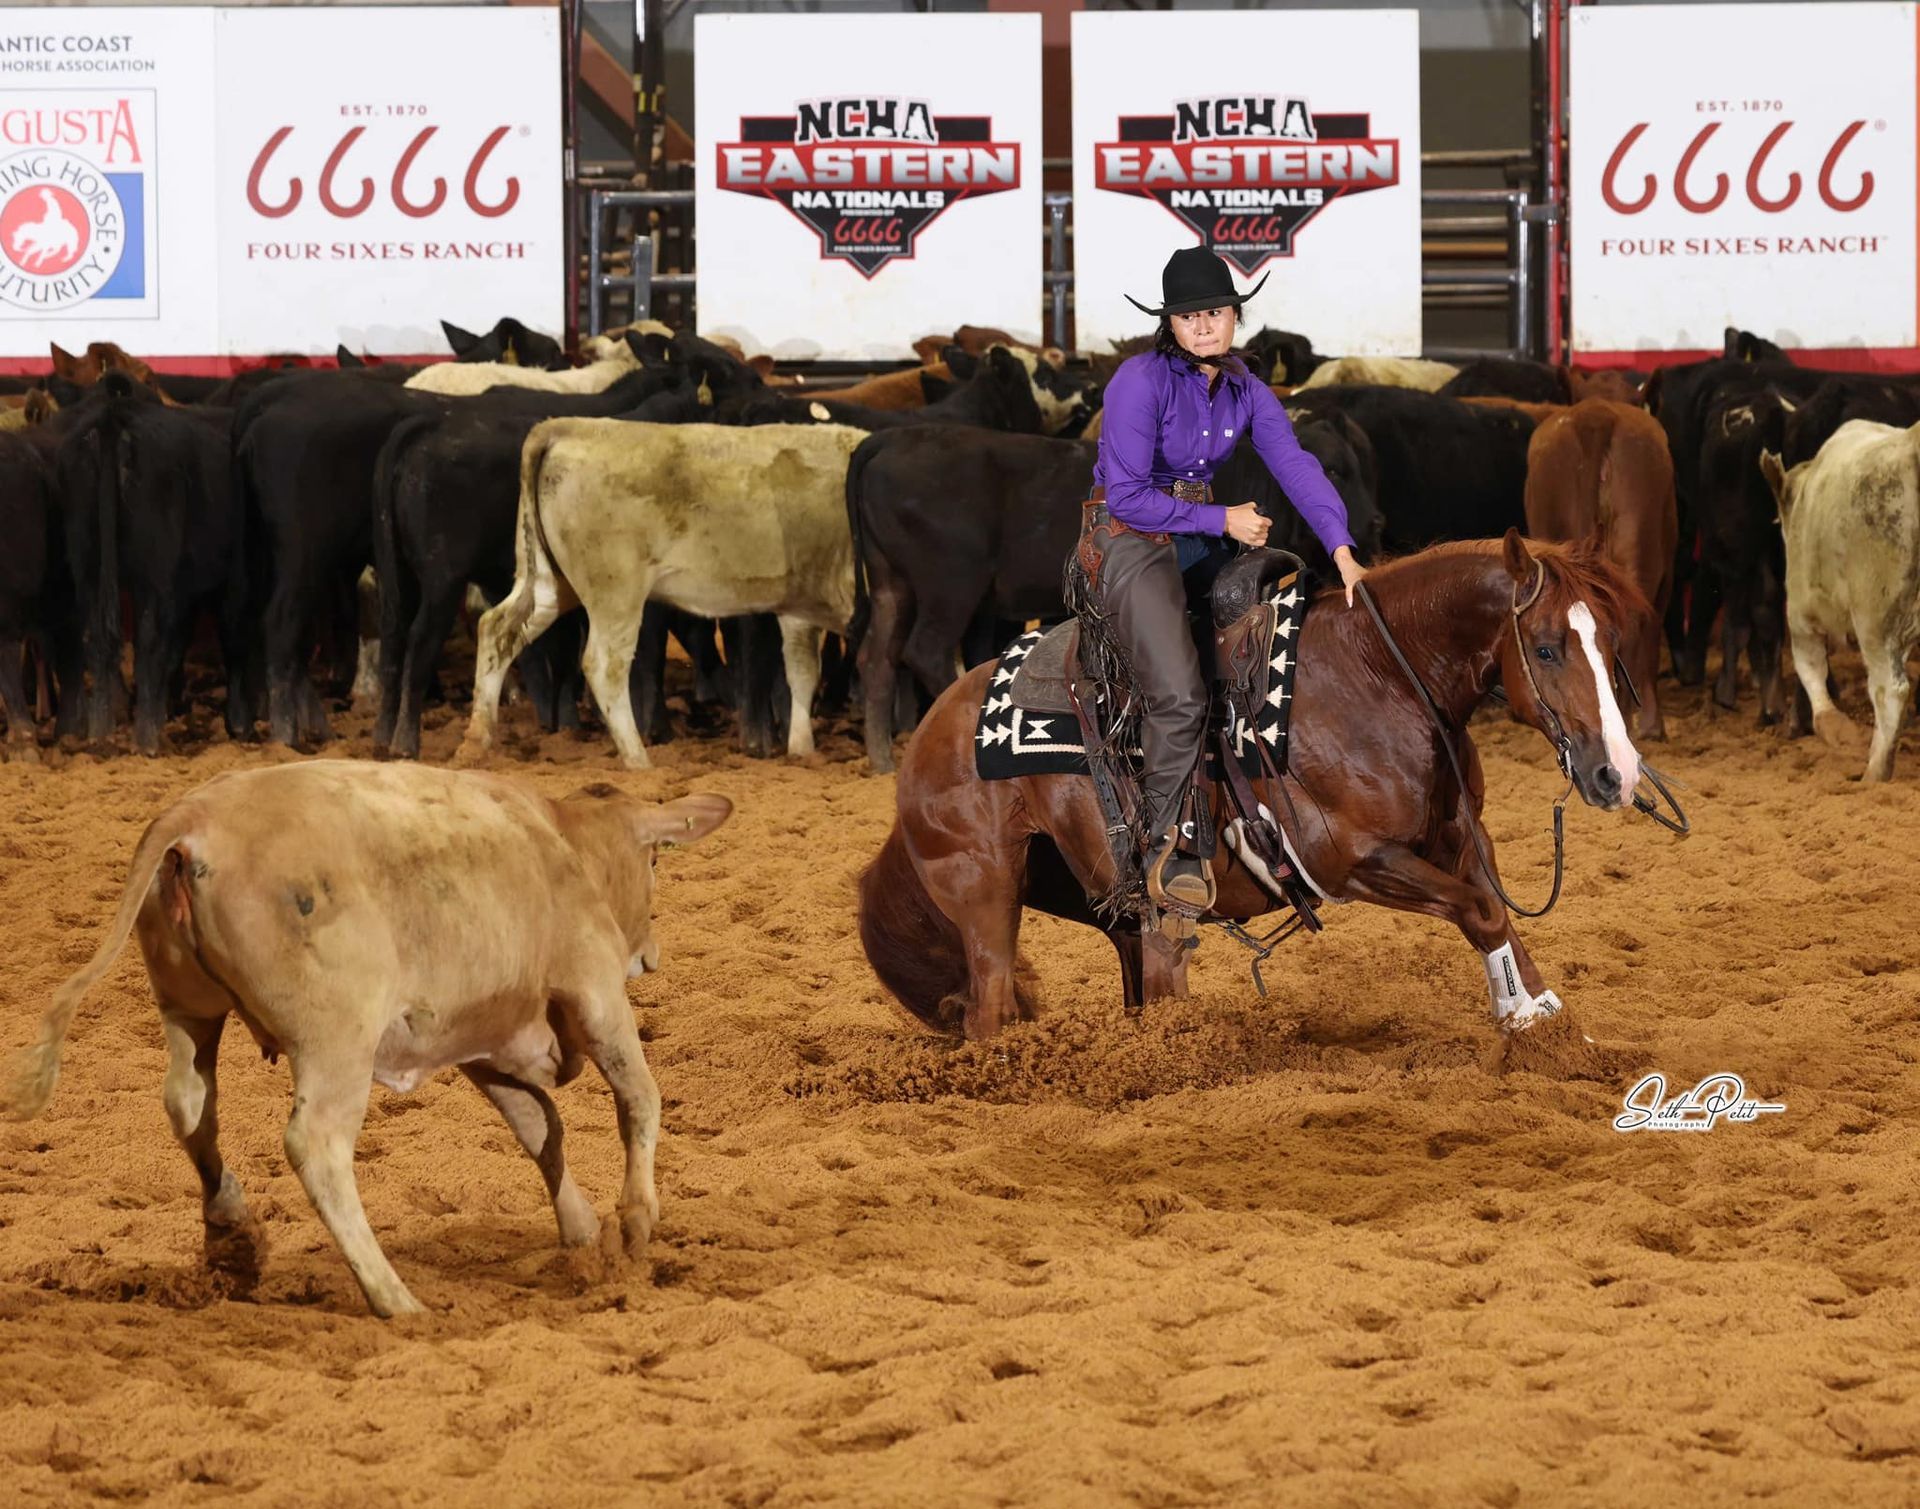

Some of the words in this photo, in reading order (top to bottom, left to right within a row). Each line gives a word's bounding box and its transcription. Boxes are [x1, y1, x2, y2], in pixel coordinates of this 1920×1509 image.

[62, 36, 133, 52] COAST
[2, 61, 51, 71] HORSE
[56, 60, 155, 71] ASSOCIATION
[340, 105, 379, 116] EST.
[387, 105, 428, 116] 1870
[1695, 101, 1735, 112] EST.
[1743, 100, 1784, 112] 1870
[797, 99, 935, 142] NCHA
[1176, 98, 1315, 140] NCHA
[2, 99, 143, 163] GUSTA
[722, 147, 1015, 184] EASTERN
[1101, 145, 1393, 183] EASTERN
[60, 160, 117, 241] HORSE
[793, 191, 944, 209] NATIONALS
[1171, 189, 1323, 207] NATIONALS
[248, 243, 321, 259] FOUR
[331, 243, 414, 259] SIXES
[424, 243, 525, 259] RANCH
[1602, 239, 1675, 256] FOUR
[1685, 239, 1769, 255] SIXES
[1779, 237, 1879, 254] RANCH
